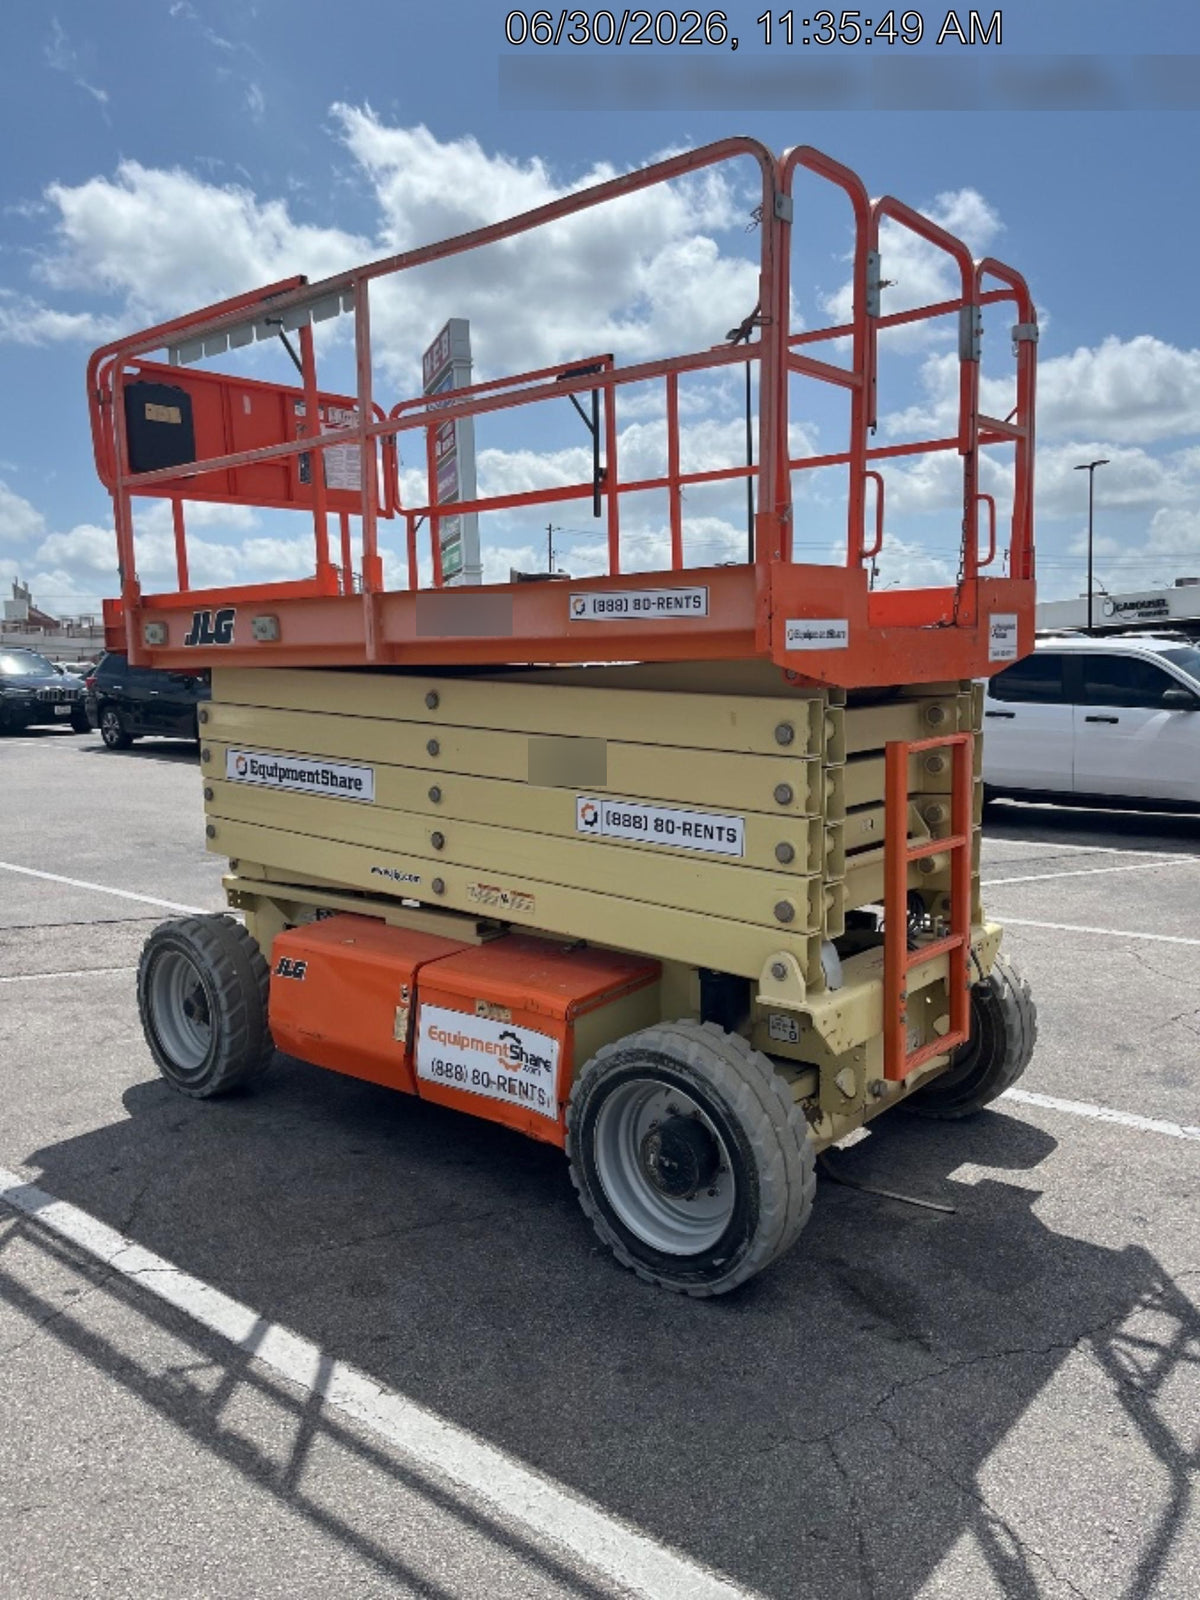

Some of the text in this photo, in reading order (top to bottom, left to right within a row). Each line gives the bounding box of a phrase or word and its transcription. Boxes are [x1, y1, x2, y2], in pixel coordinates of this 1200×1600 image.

[593, 595, 702, 613] (888) 80-RENTS
[184, 608, 237, 647] JLG
[250, 758, 363, 792] EquipmentShare
[605, 810, 738, 844] (888) 80-RENTS
[274, 956, 308, 981] JLG
[427, 1025, 553, 1073] EquipmentShare
[431, 1056, 468, 1084] (888)
[471, 1068, 546, 1107] 80-RENTS
